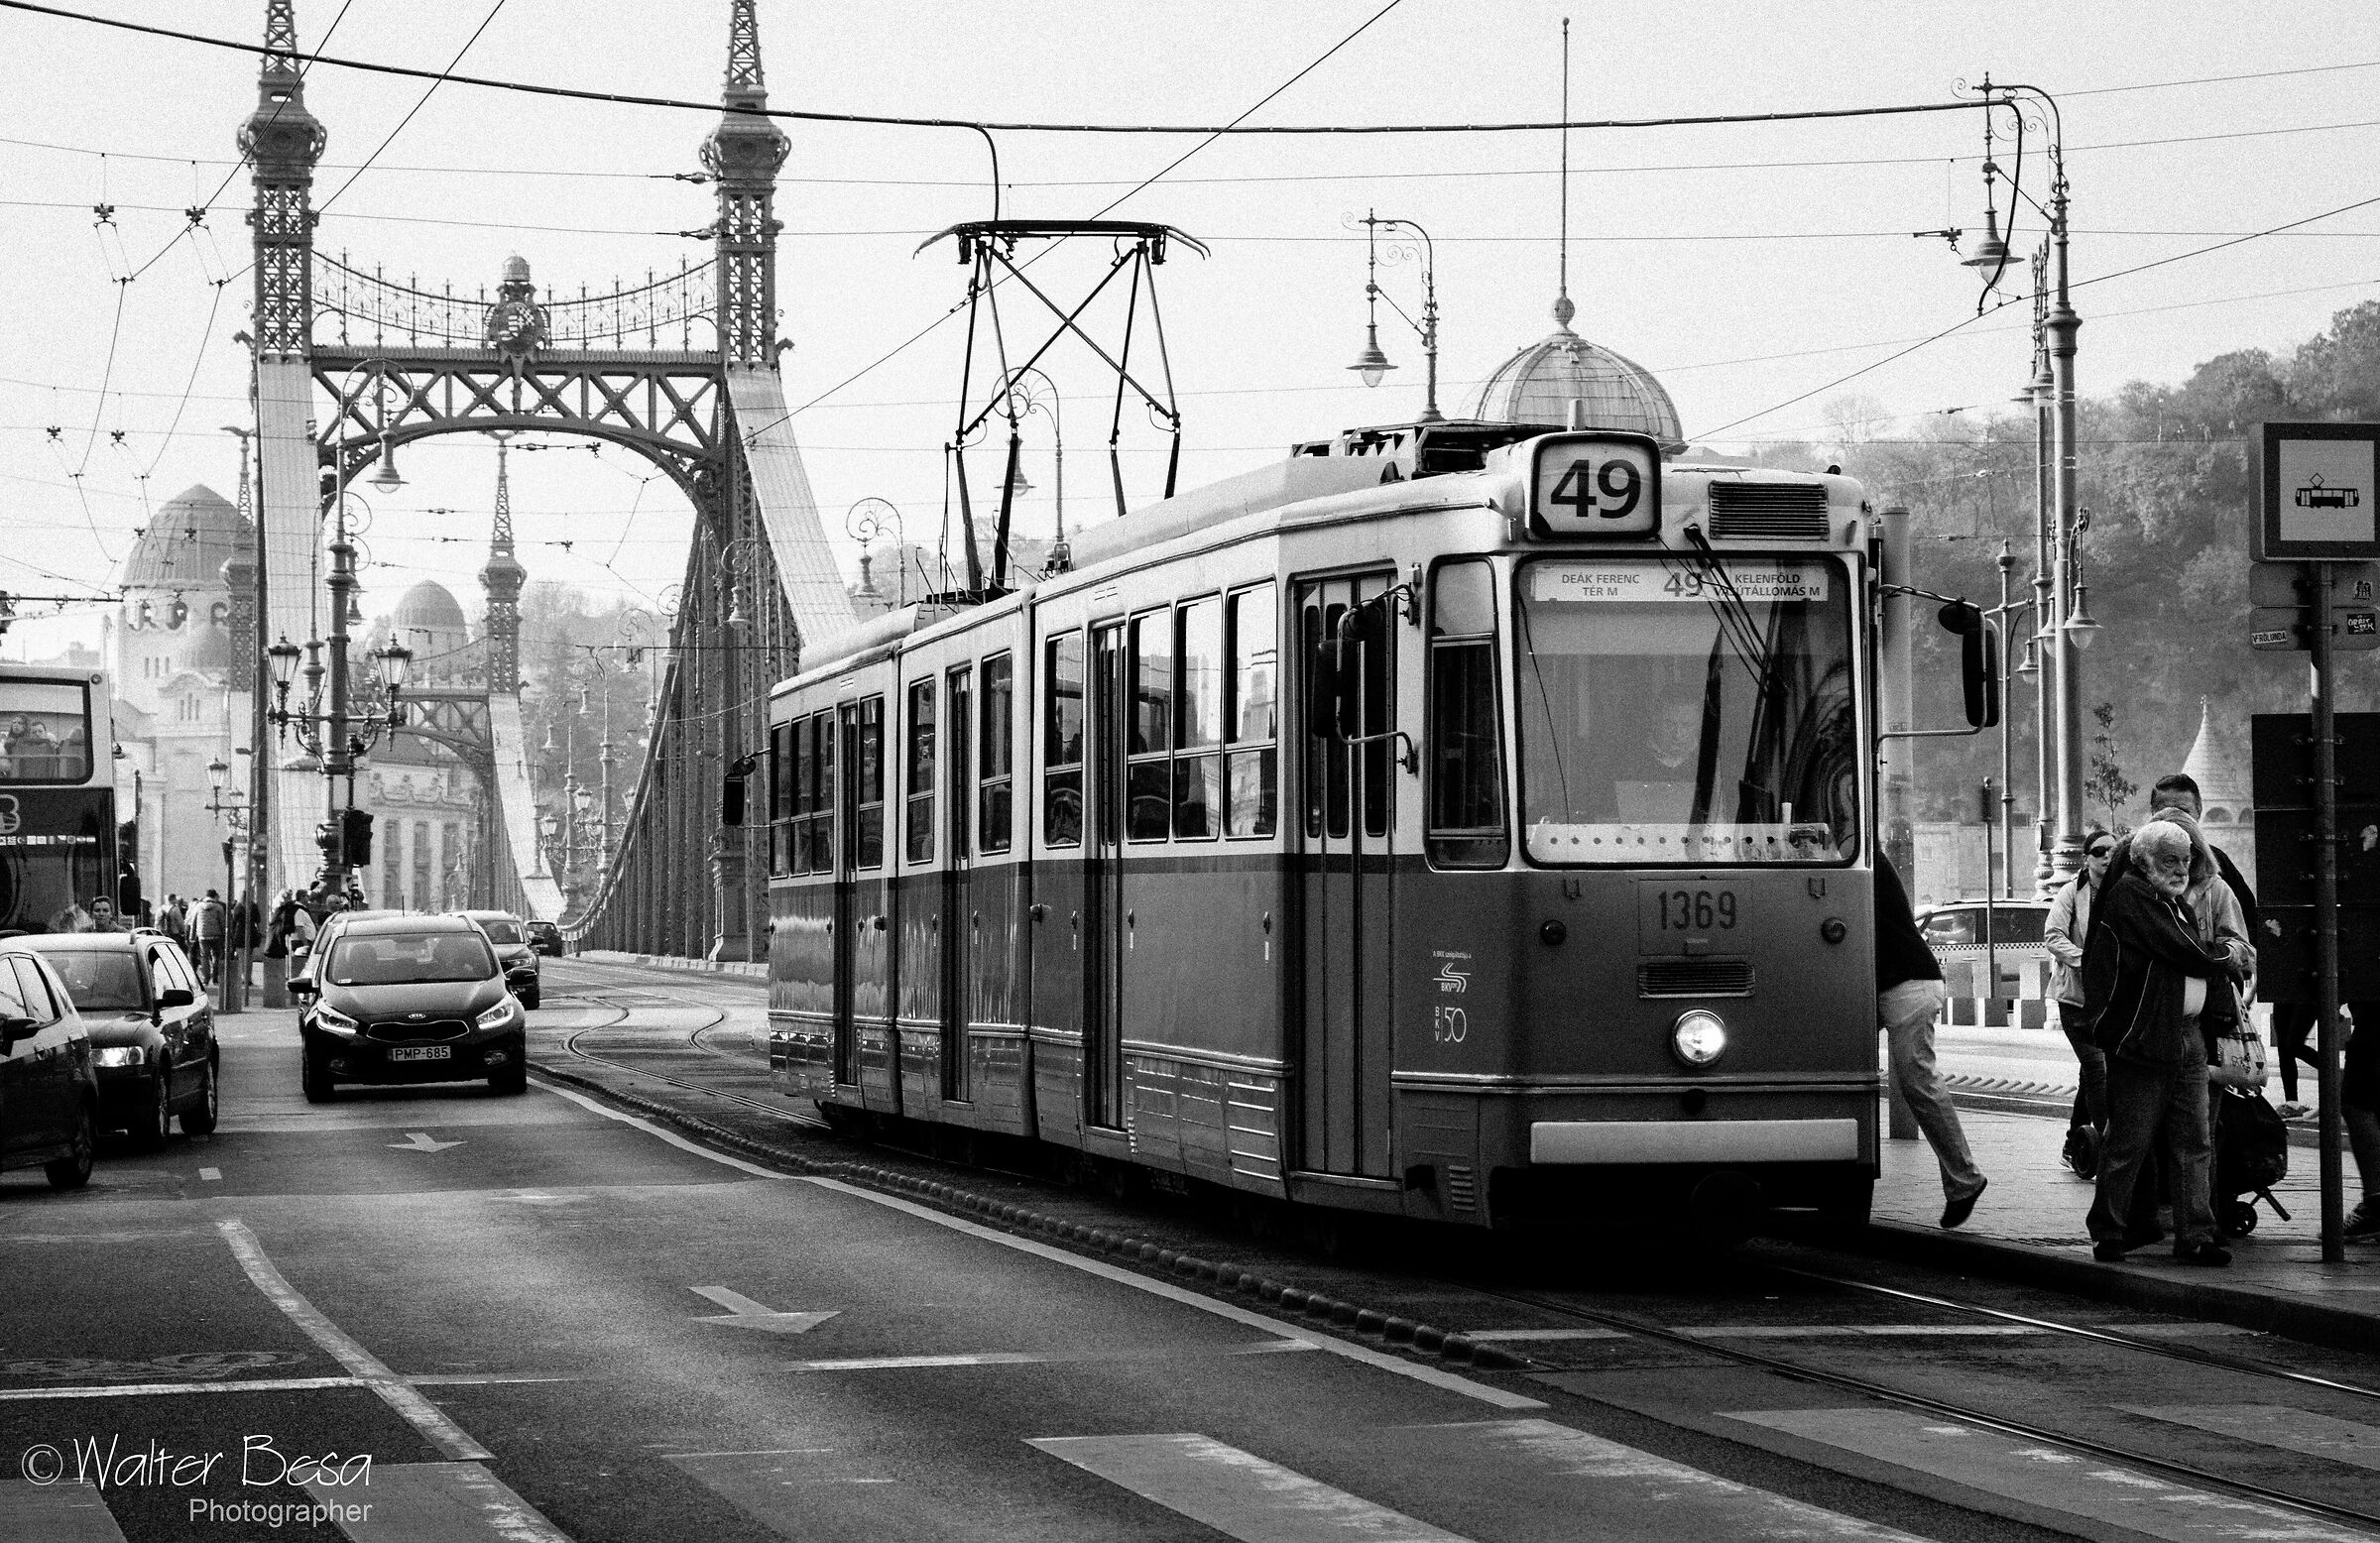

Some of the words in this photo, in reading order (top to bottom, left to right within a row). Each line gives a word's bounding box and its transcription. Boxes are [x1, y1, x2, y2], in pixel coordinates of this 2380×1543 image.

[1550, 458, 1641, 520] 49
[1562, 573, 1593, 584] DEÁK
[1596, 574, 1640, 584] FERENC
[1663, 572, 1703, 598] 49
[1734, 572, 1801, 584] KELENFÖLD
[1583, 585, 1604, 596] TÉR
[1606, 587, 1619, 596] M
[1809, 586, 1821, 596] M
[1658, 890, 1737, 930] 1369
[1444, 1008, 1467, 1042] 50
[395, 1046, 448, 1060] PMP-685
